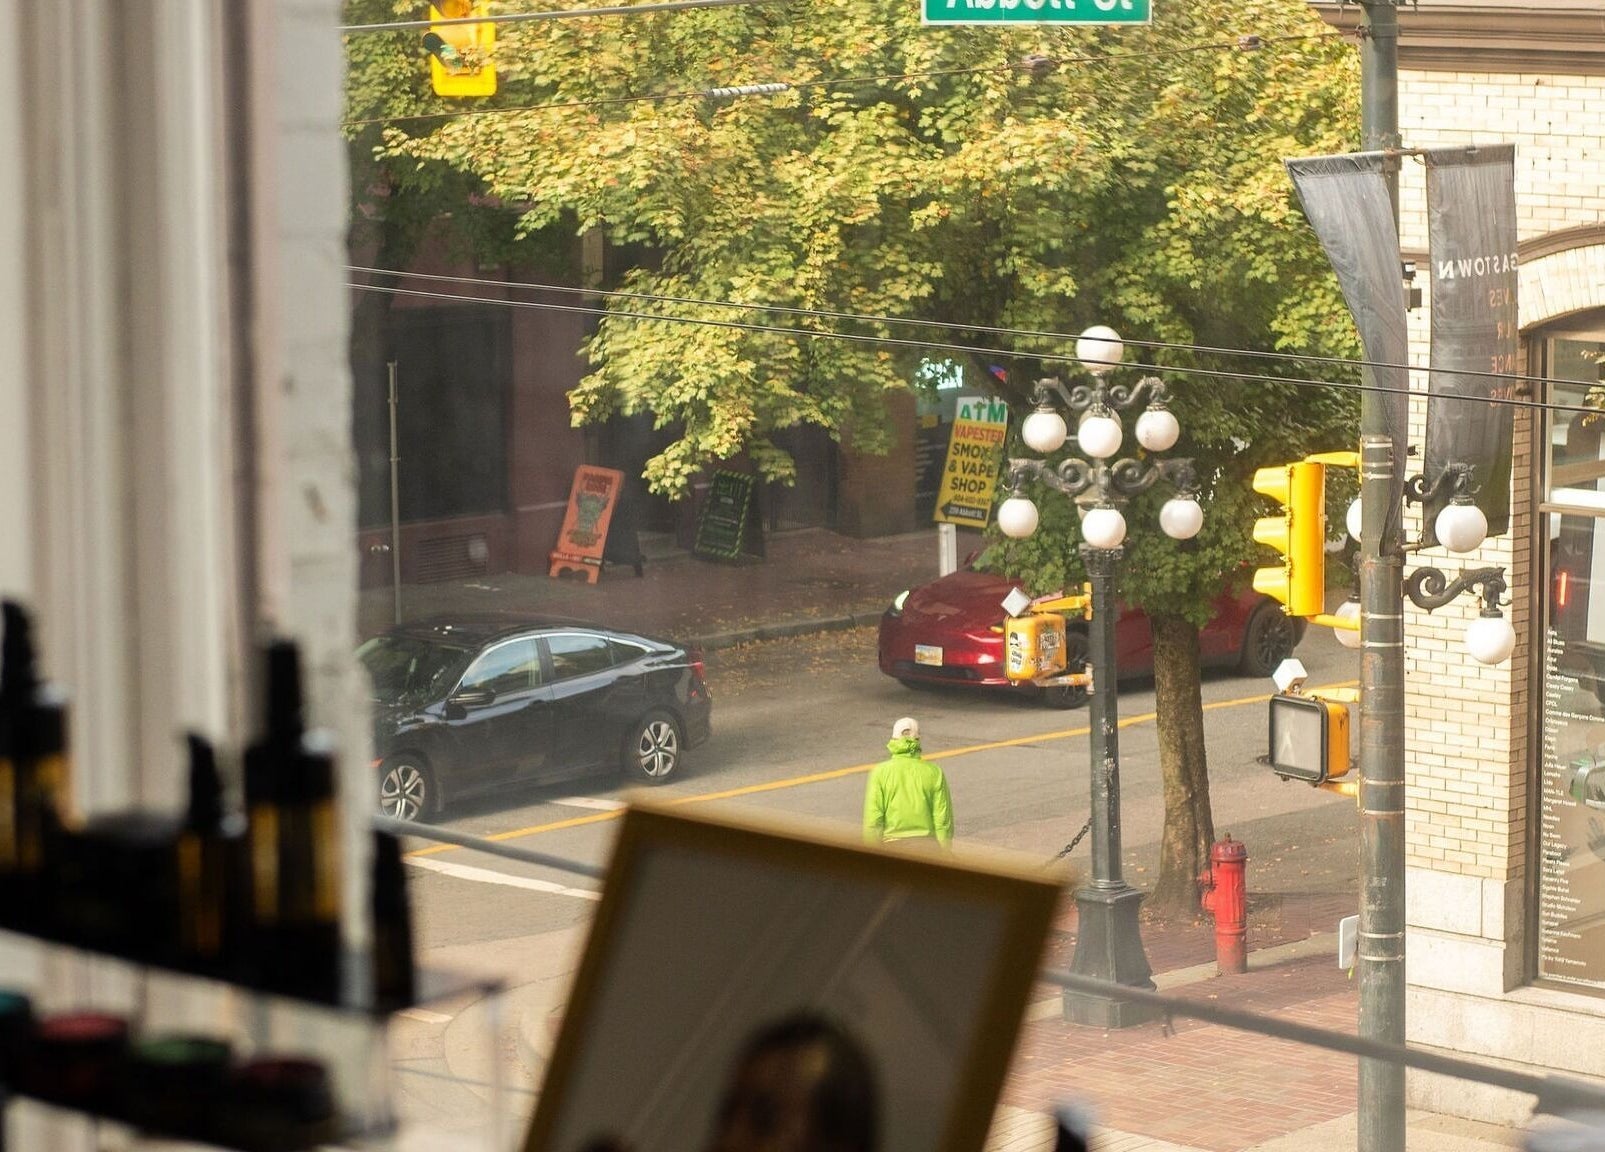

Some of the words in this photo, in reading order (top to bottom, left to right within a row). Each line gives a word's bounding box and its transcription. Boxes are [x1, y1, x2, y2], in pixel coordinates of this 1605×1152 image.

[960, 402, 1006, 422] ATM
[955, 424, 1004, 442] VAPESTER
[953, 443, 994, 460] SMOK
[948, 460, 957, 472] &
[961, 460, 993, 477] VAPE
[950, 477, 986, 493] SHOP
